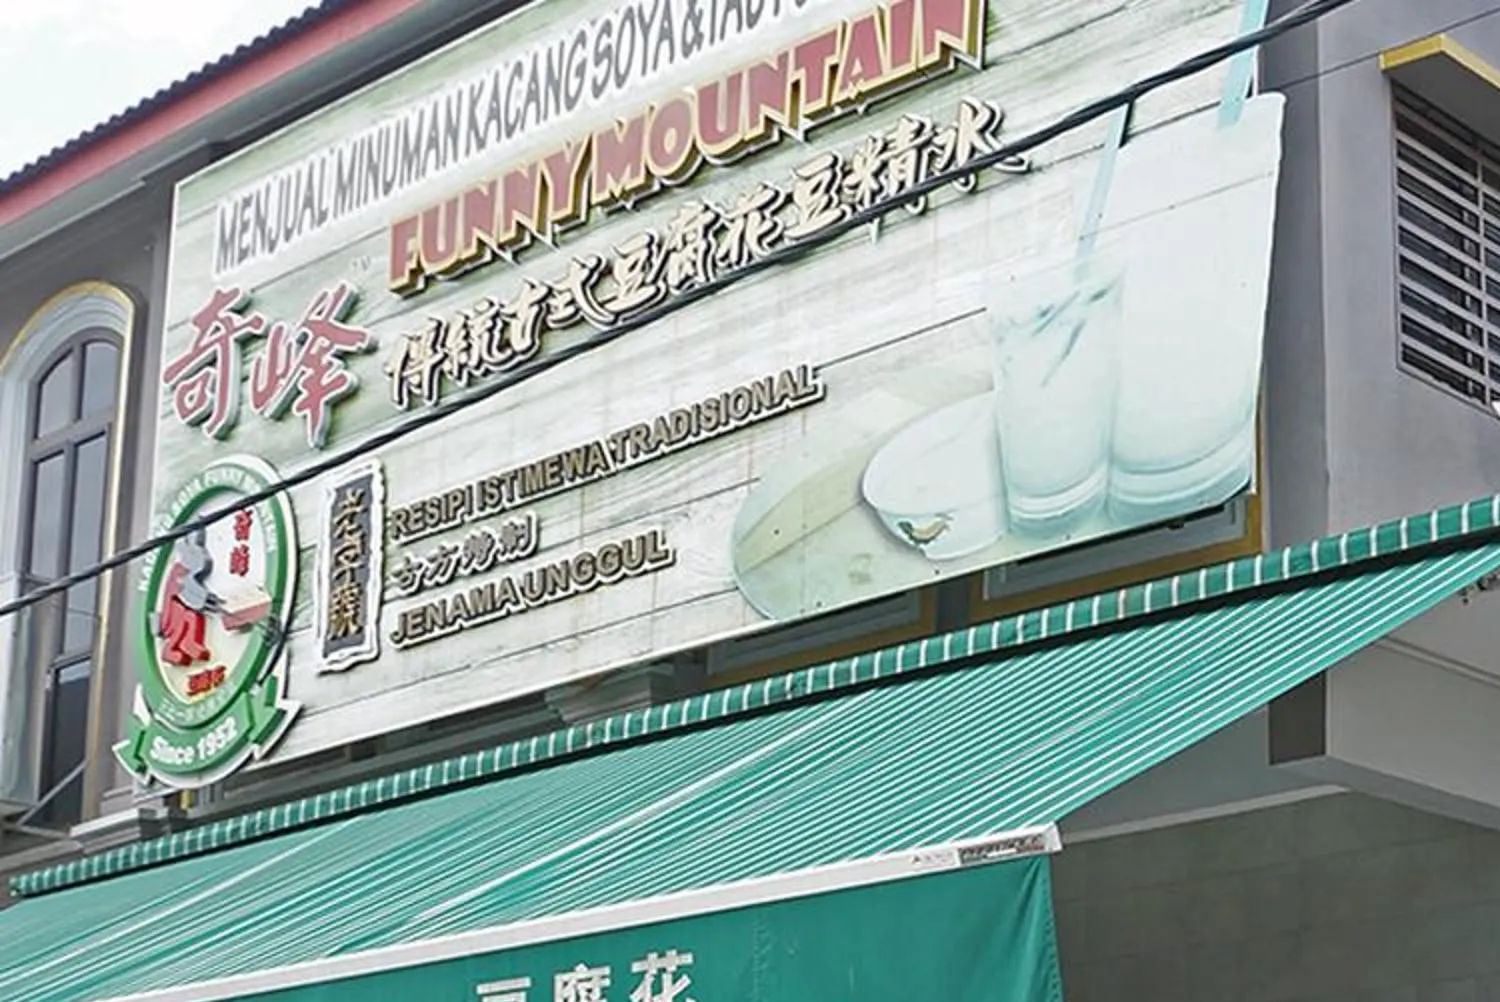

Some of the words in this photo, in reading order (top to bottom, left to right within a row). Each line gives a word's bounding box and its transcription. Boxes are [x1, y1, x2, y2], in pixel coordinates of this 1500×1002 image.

[216, 152, 329, 273] MENJUAL
[333, 90, 463, 219] MINUMAN
[465, 30, 587, 158] KACANG
[592, 0, 675, 98] SOYA
[390, 136, 590, 290] FUNNY
[592, 0, 974, 203] MOUNTAIN
[163, 284, 368, 444] 奇峰
[392, 482, 474, 540] RESIPI
[475, 447, 609, 511] ISTIMEWA
[610, 364, 818, 462] TRADISIONAL
[390, 576, 518, 643] JENAMA
[522, 530, 670, 600] UNGGUL
[197, 716, 237, 760] 1952
